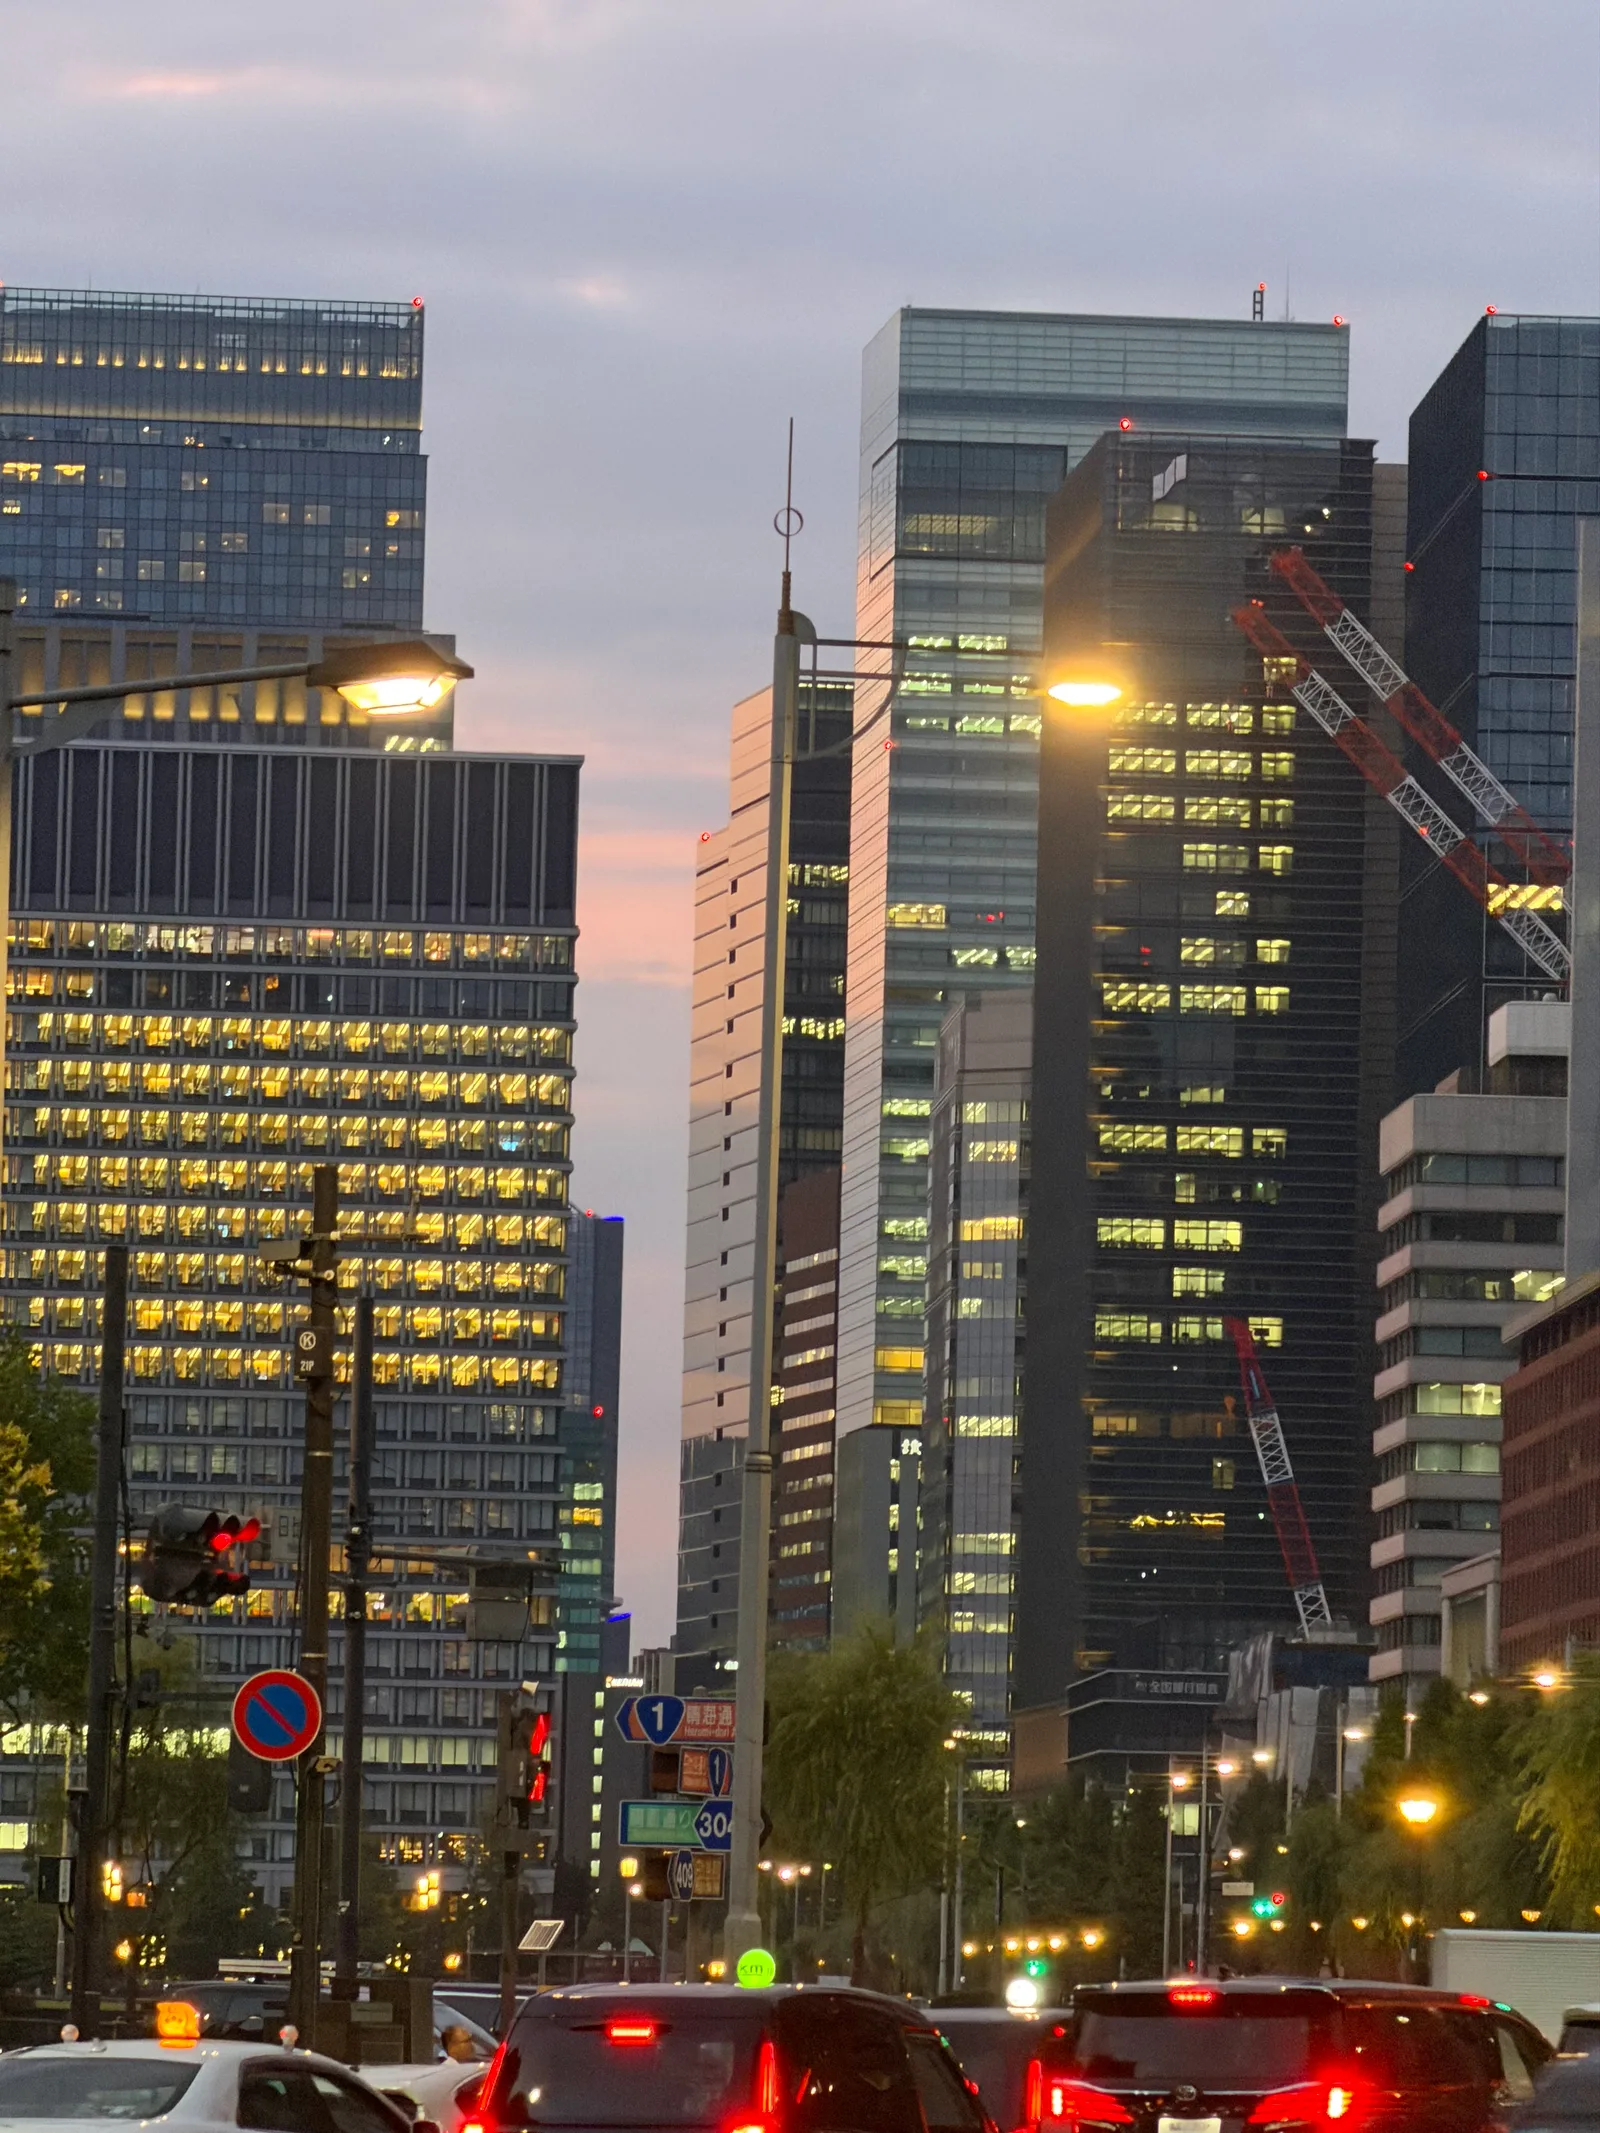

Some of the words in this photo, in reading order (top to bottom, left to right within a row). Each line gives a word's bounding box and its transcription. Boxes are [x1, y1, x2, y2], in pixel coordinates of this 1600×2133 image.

[300, 1360, 315, 1372] 21P
[652, 1702, 664, 1731] 1
[714, 1753, 720, 1785] 1
[677, 1862, 693, 1889] 409
